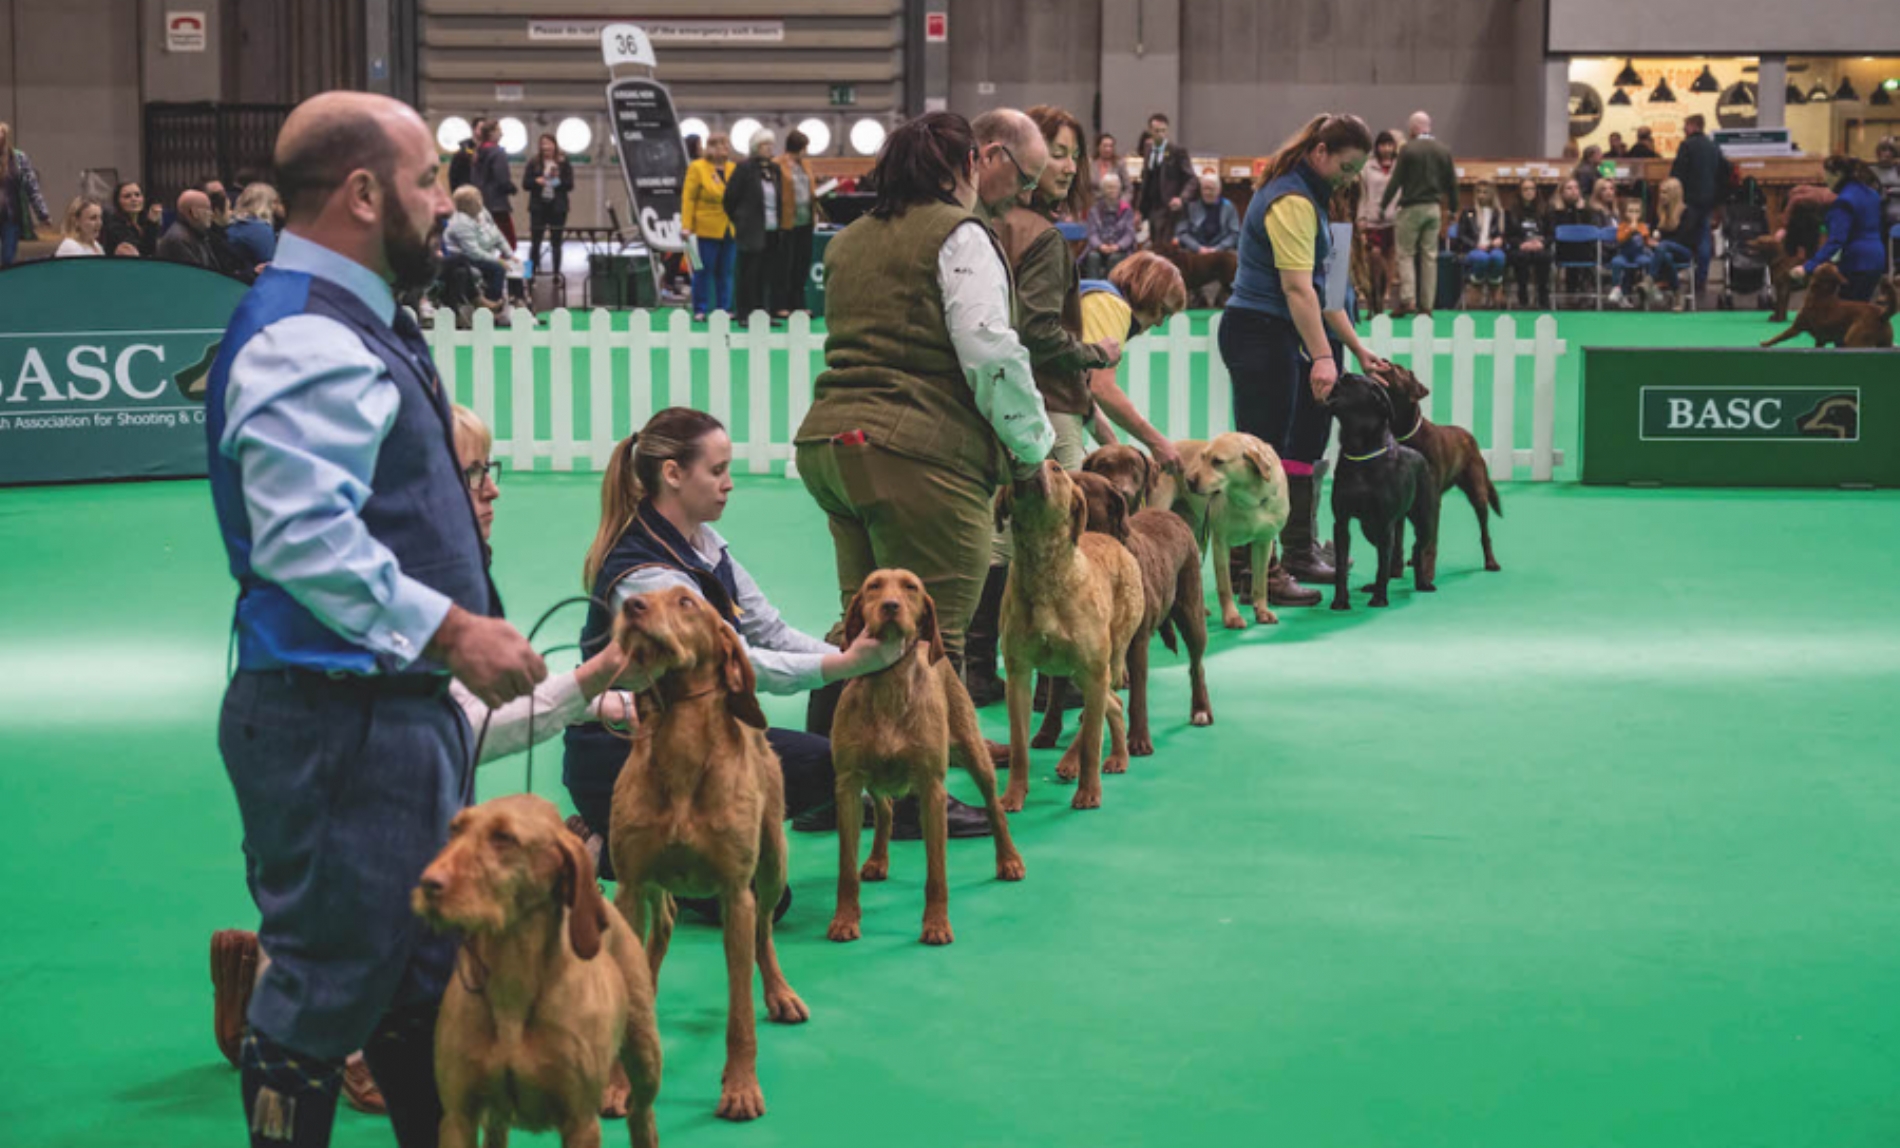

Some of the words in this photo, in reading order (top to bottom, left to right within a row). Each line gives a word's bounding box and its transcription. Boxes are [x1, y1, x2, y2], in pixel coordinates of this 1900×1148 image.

[615, 33, 638, 55] 36
[0, 344, 168, 402] ASC
[14, 413, 91, 429] Association
[94, 413, 113, 427] for
[117, 411, 176, 427] Shooting
[179, 410, 190, 424] &
[1667, 398, 1782, 429] BASC
